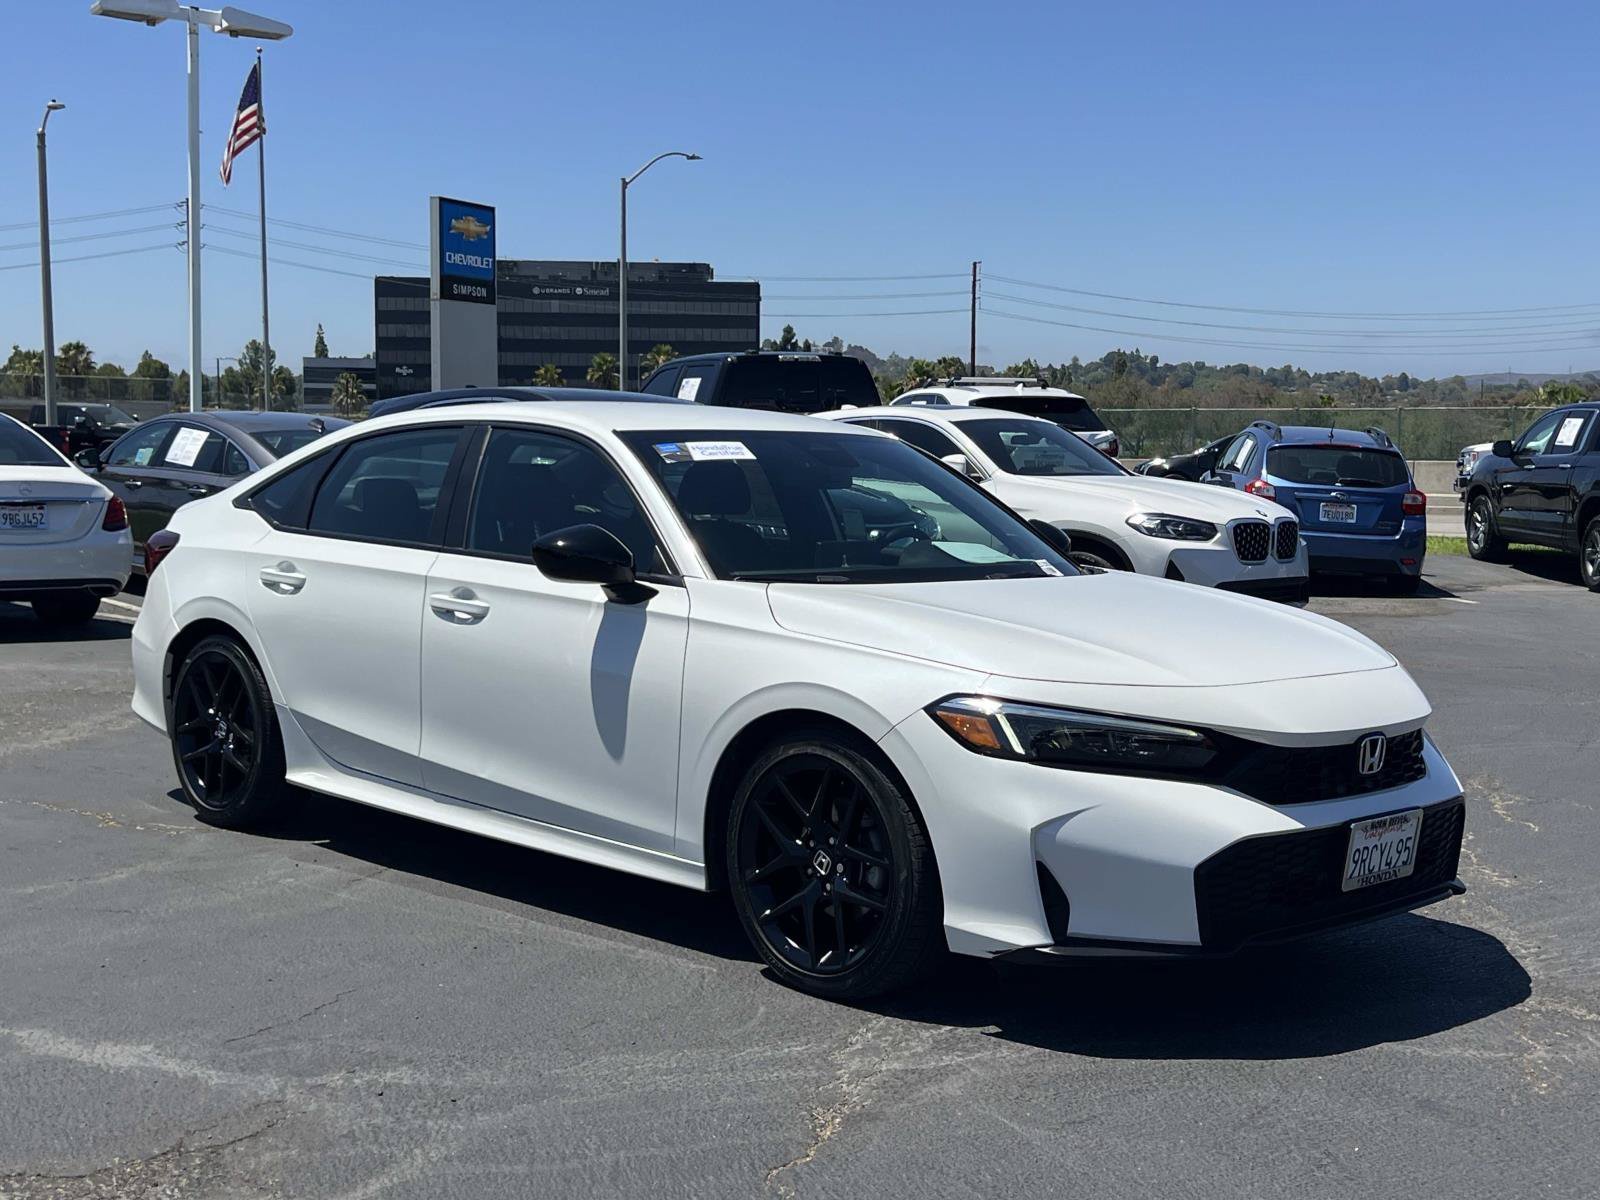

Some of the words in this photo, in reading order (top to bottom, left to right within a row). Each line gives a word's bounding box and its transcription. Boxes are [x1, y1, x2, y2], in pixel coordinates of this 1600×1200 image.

[446, 252, 493, 268] CHEVROLET
[453, 284, 487, 297] SIMPSON
[583, 287, 610, 296] Smead
[1349, 837, 1412, 879] 9RCY495
[1359, 868, 1400, 887] HONDA
